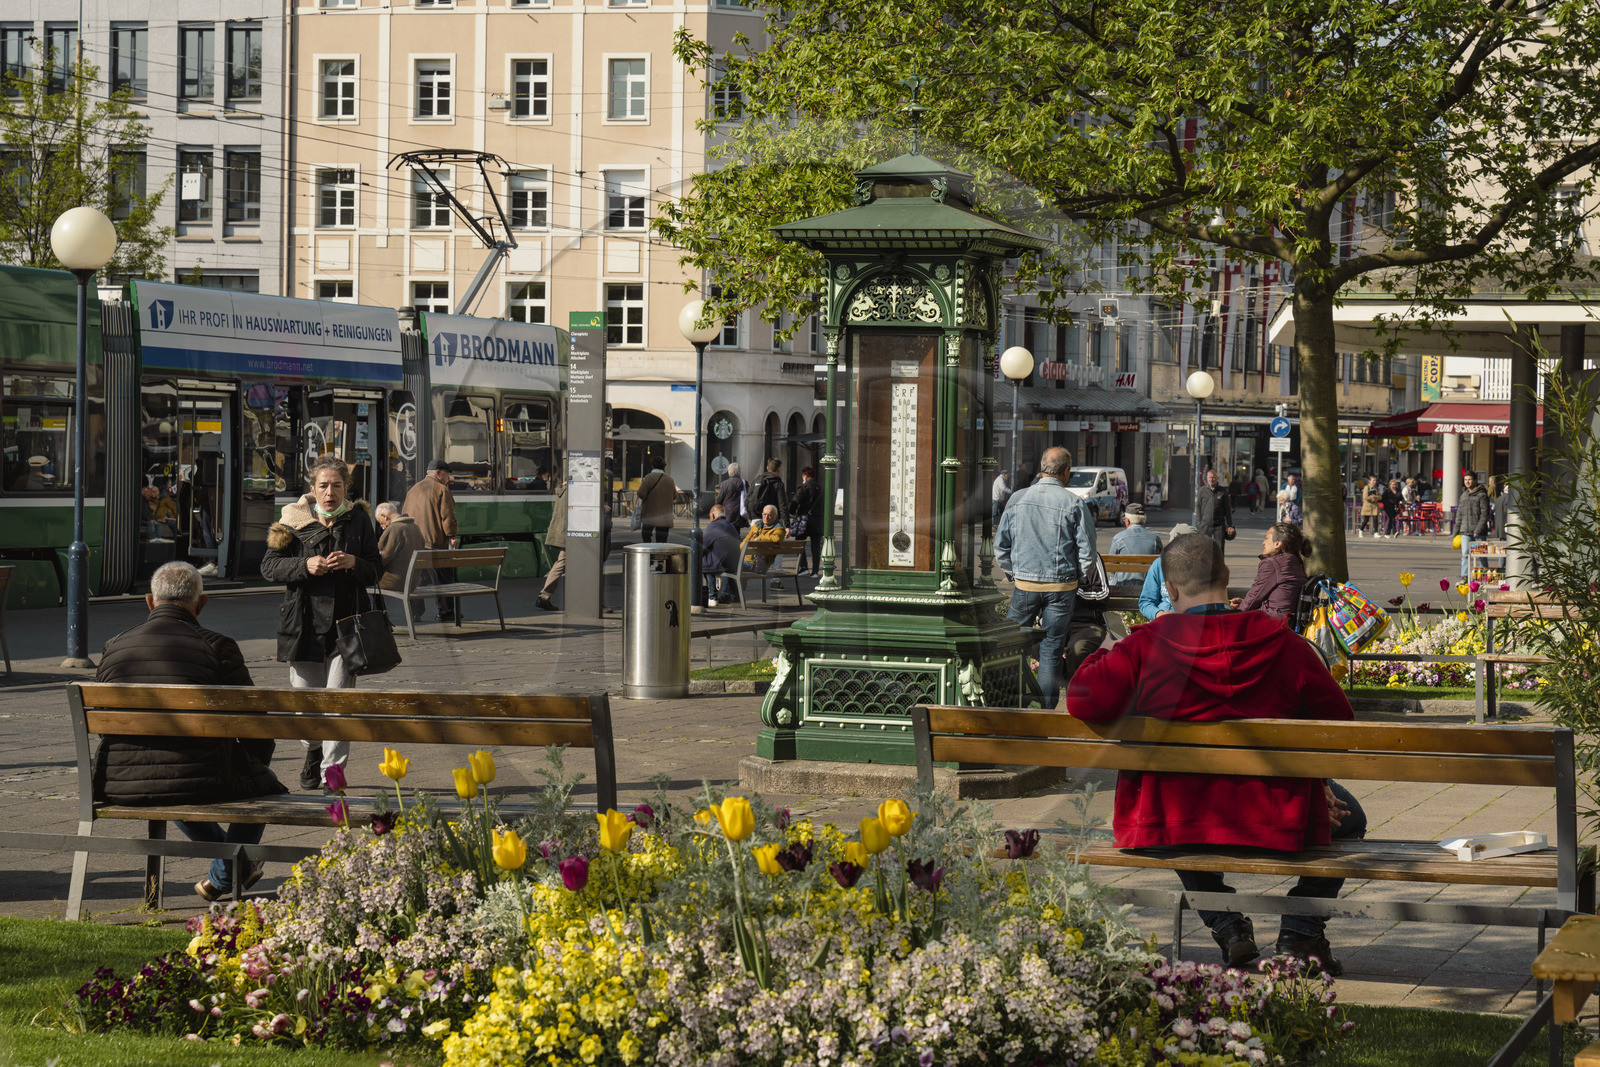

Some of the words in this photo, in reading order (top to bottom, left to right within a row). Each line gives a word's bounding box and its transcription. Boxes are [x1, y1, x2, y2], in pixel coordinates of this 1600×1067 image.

[178, 309, 197, 326] IHR
[200, 312, 230, 328] PROFI
[232, 314, 243, 329] IN
[246, 315, 322, 336] HAUSWARTUNG
[324, 328, 330, 336] +
[332, 324, 392, 342] REINIGUNGEN
[460, 334, 555, 366] BRODMANN
[248, 359, 314, 372] www.brodmann.net
[1115, 374, 1135, 387] H&M
[895, 389, 899, 397] C
[902, 389, 906, 397] R
[910, 389, 914, 397] F
[1434, 424, 1452, 432] ZUM
[1454, 424, 1490, 434] SCHIEFEN
[1492, 426, 1508, 434] ECK
